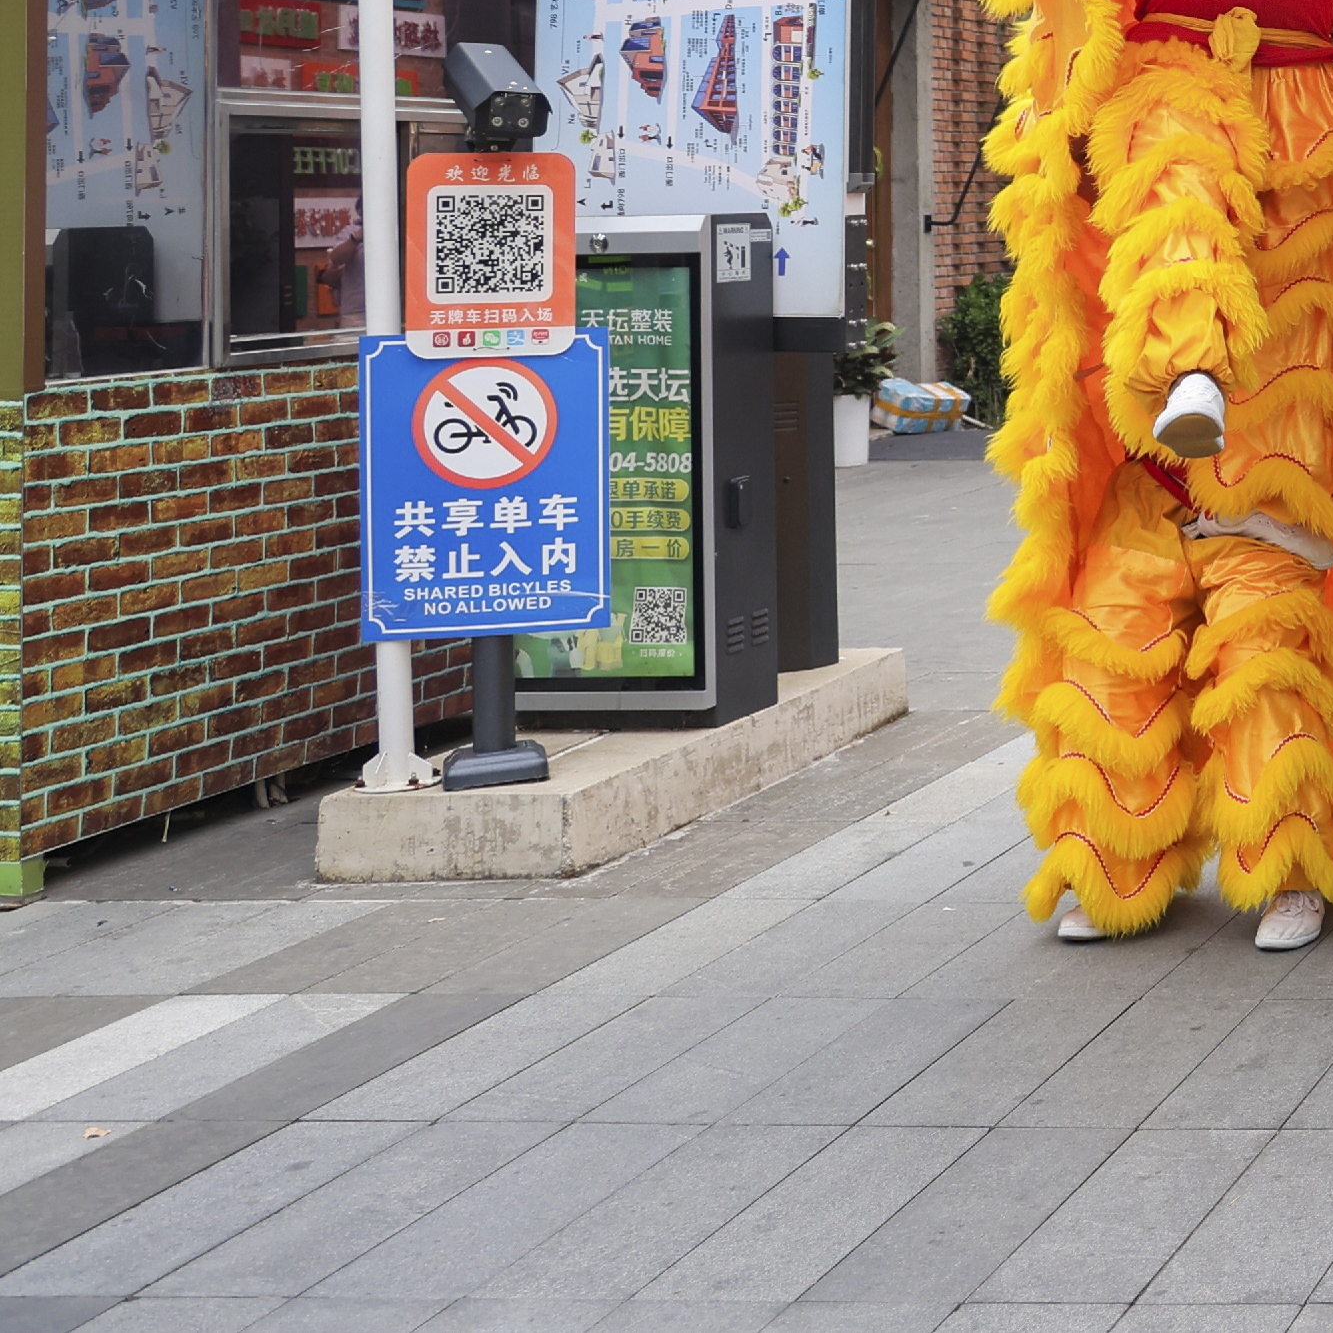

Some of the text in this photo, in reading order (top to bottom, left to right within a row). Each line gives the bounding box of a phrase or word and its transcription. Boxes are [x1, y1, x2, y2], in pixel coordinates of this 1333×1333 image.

[550, 14, 558, 29] 798
[445, 165, 540, 182] 欢迎光临
[430, 307, 553, 325] 无牌车扫码入场
[581, 309, 672, 332] 天坛整装
[638, 336, 672, 346] HOME
[394, 494, 579, 539] 共享单车
[394, 537, 577, 582] 禁止入内
[403, 579, 572, 601] SHARED BICYLES
[424, 595, 551, 616] NO ALLOWED
